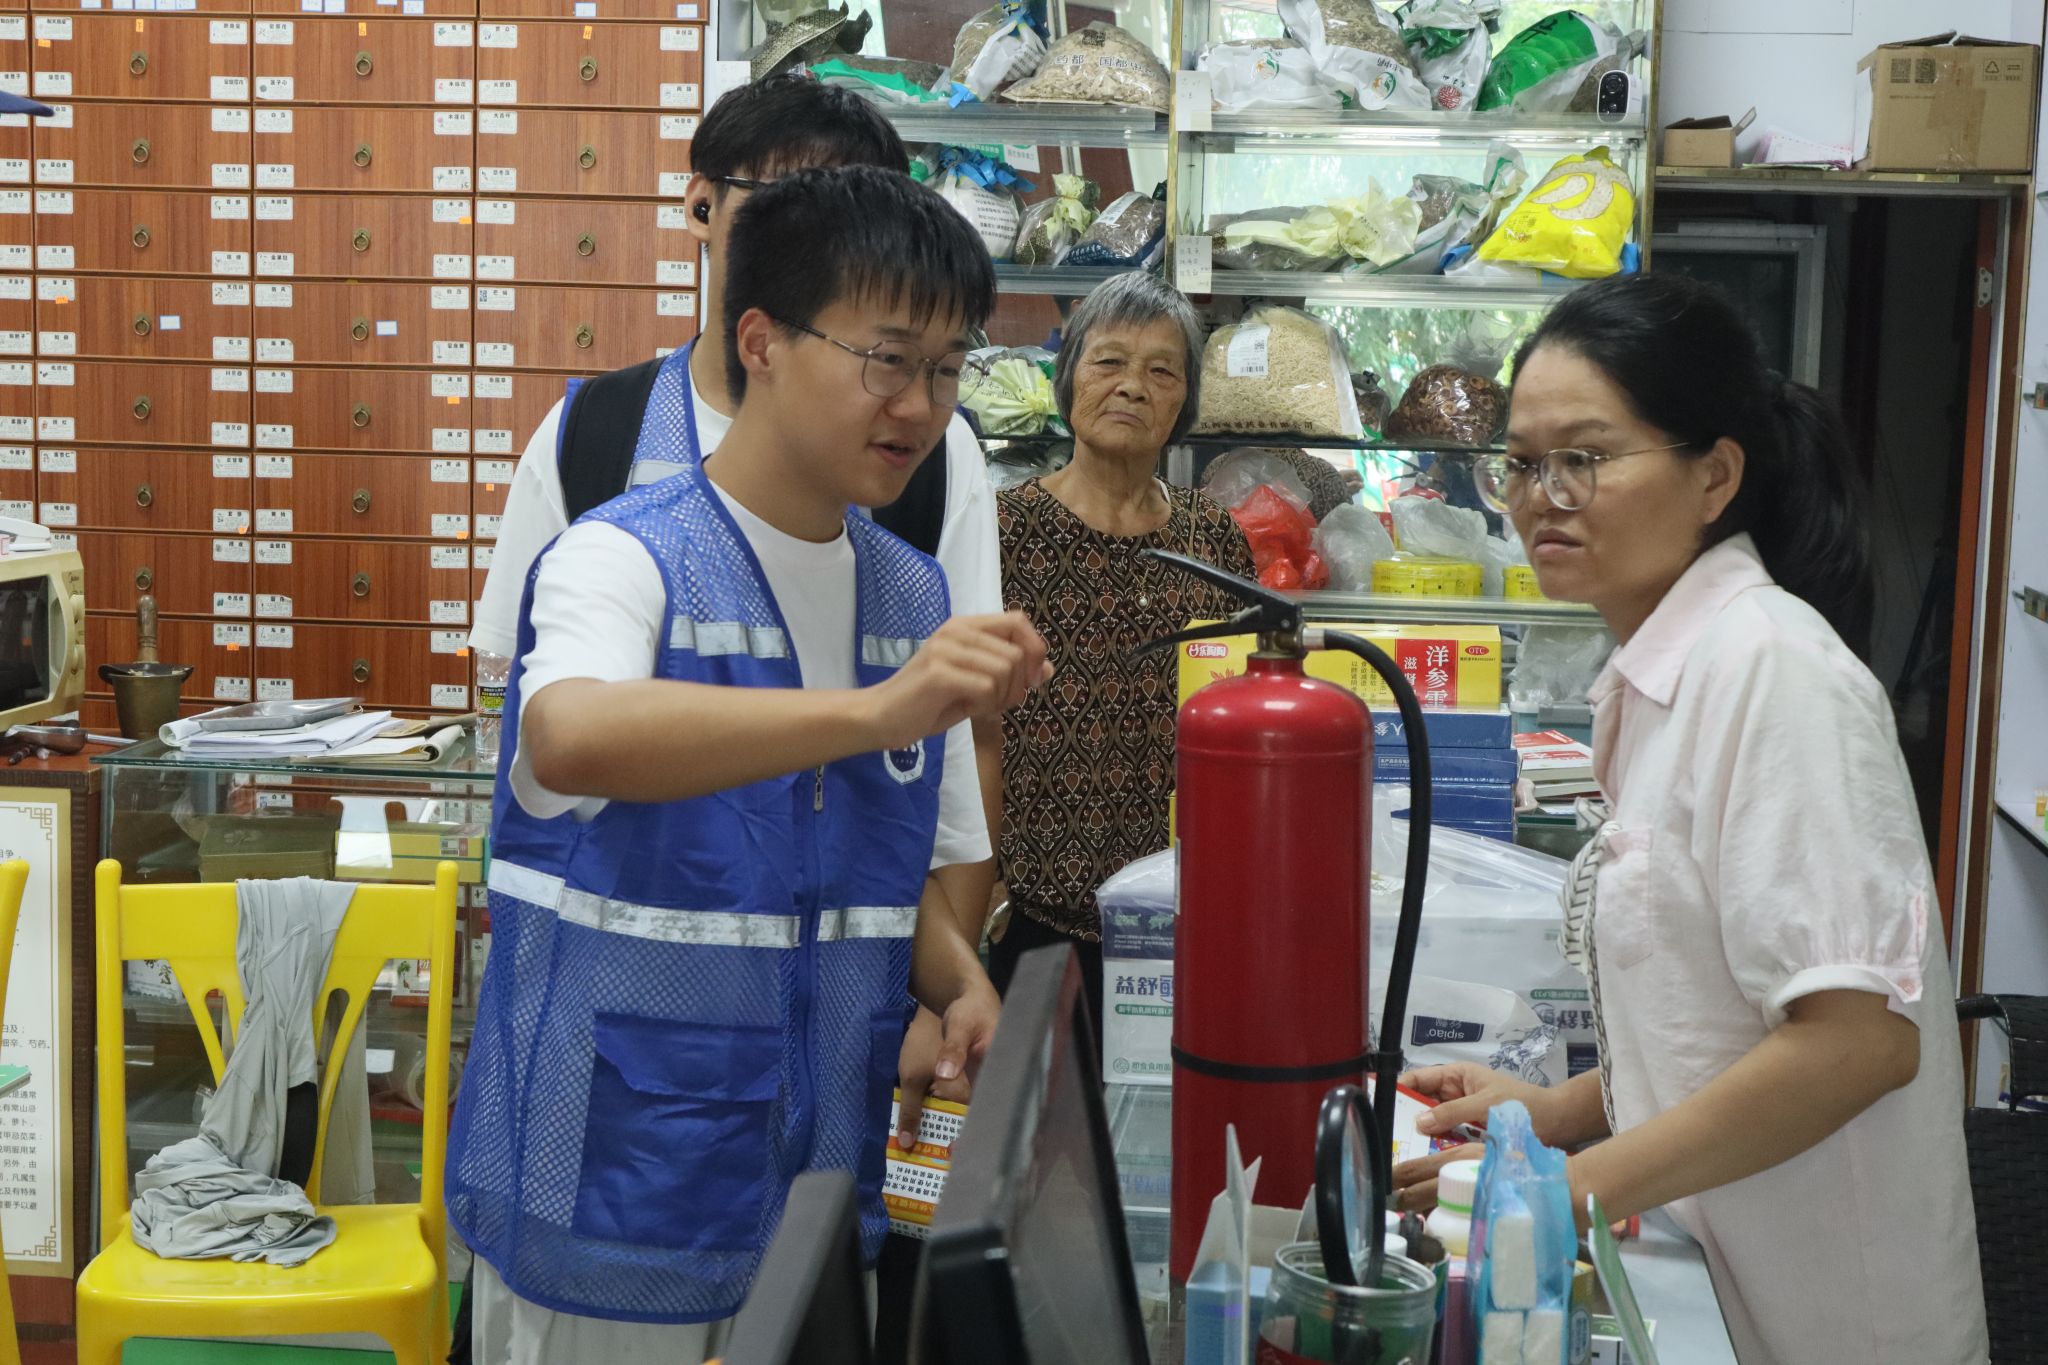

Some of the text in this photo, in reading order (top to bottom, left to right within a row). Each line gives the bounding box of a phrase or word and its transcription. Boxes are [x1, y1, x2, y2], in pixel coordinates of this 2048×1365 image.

[1199, 645, 1227, 657] 乐陶陶
[1468, 647, 1486, 655] OTC
[1429, 1028, 1465, 1040] sipiao
